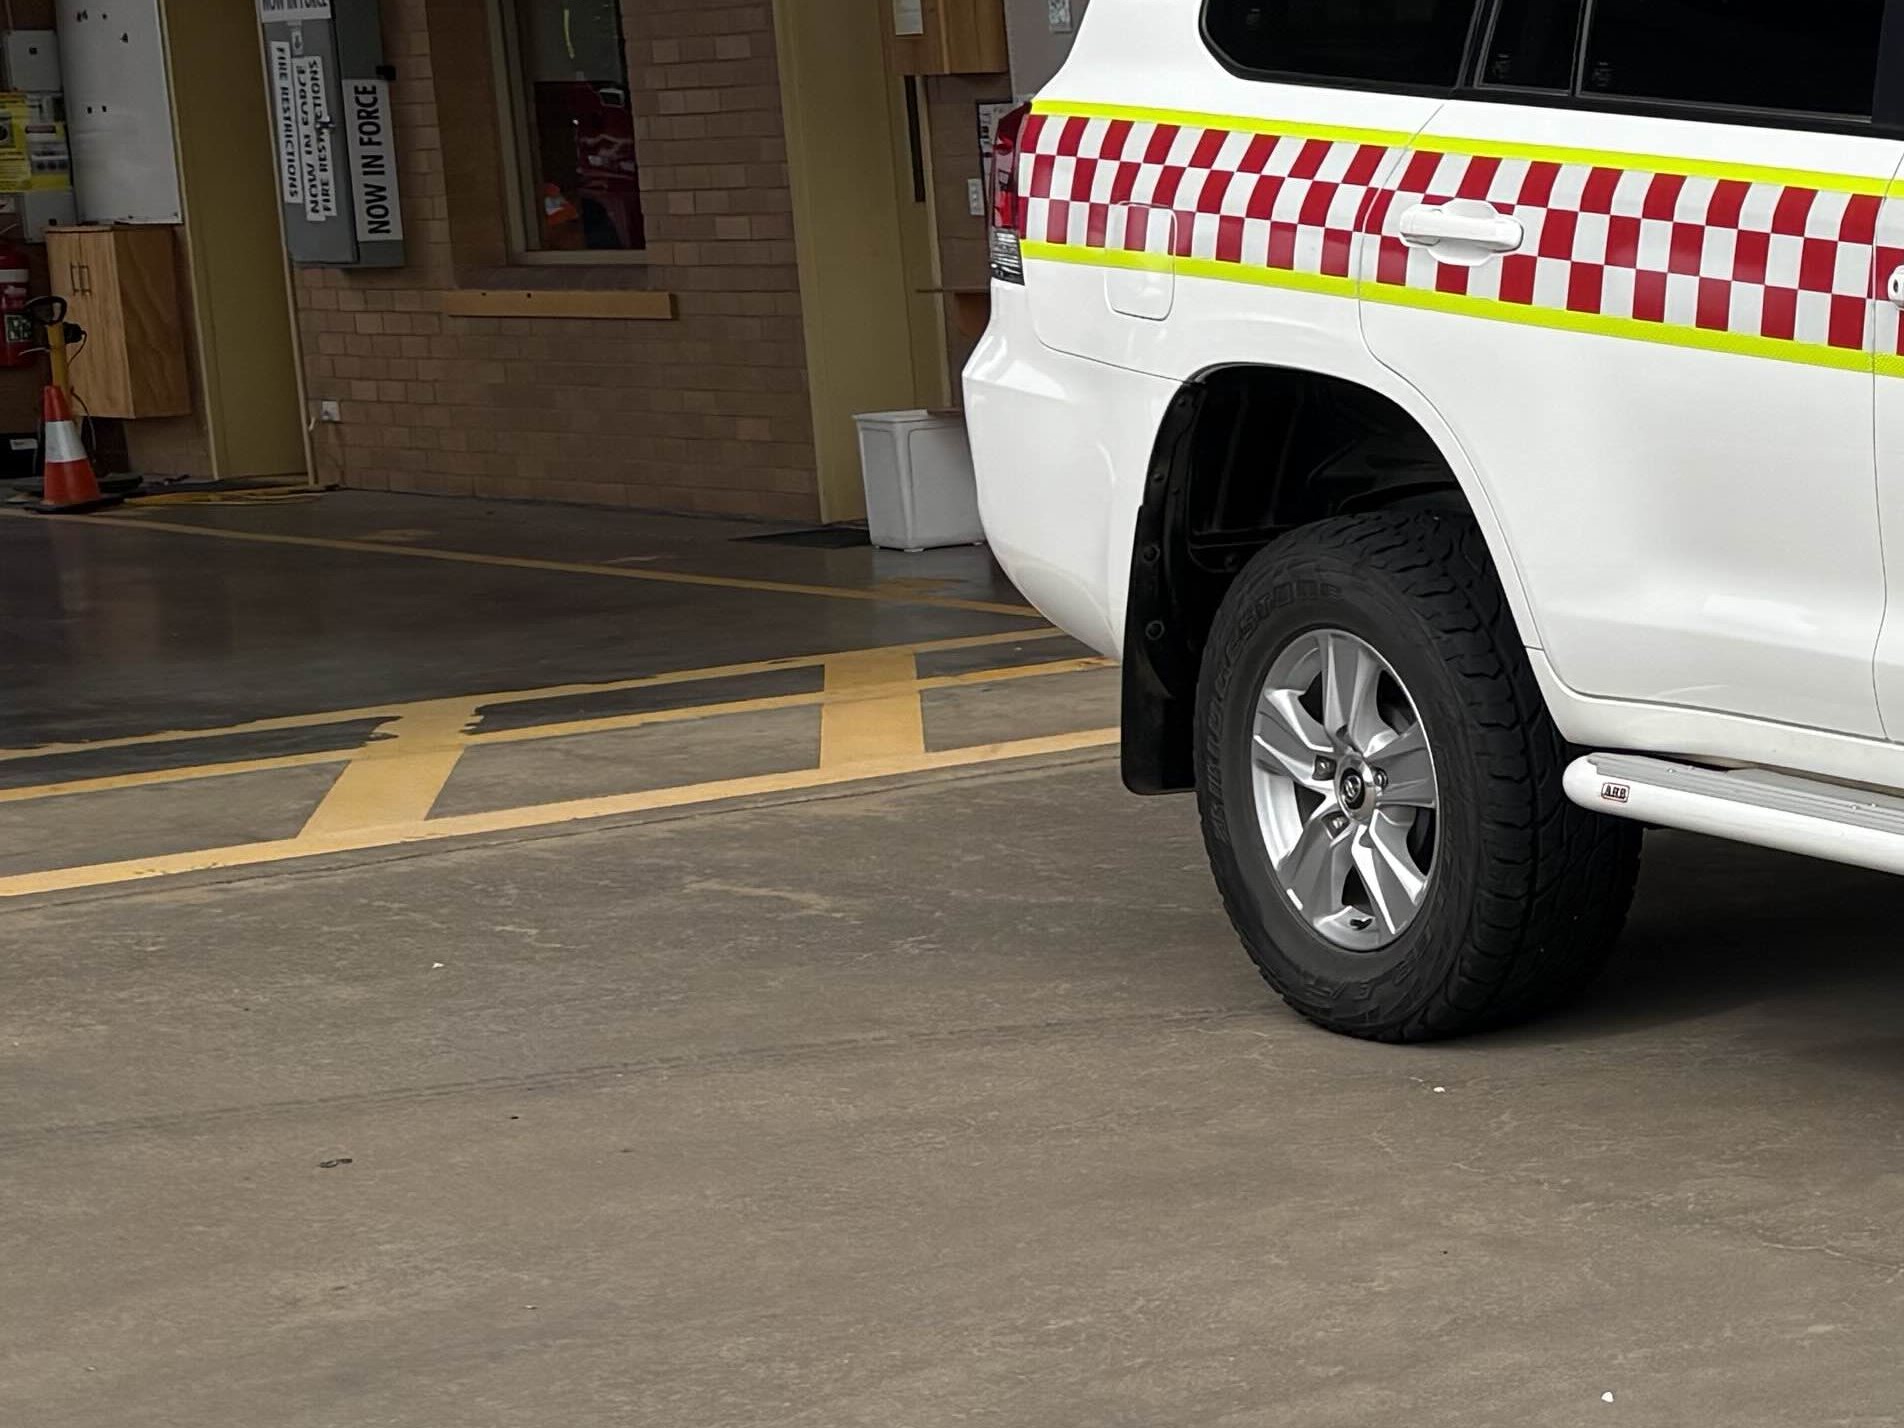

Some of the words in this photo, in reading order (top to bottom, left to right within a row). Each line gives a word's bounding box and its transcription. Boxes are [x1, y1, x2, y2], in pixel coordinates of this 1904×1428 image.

[276, 46, 289, 81] FIRE
[308, 59, 328, 172] RESTCTIONS
[354, 84, 384, 147] FORCE
[280, 86, 299, 198] RESTRICTIONS
[303, 134, 313, 156] IN
[360, 155, 386, 177] IN
[304, 162, 320, 214] NOW
[318, 177, 332, 212] FIRE
[364, 183, 392, 235] NOW
[1604, 785, 1627, 800] ARB
